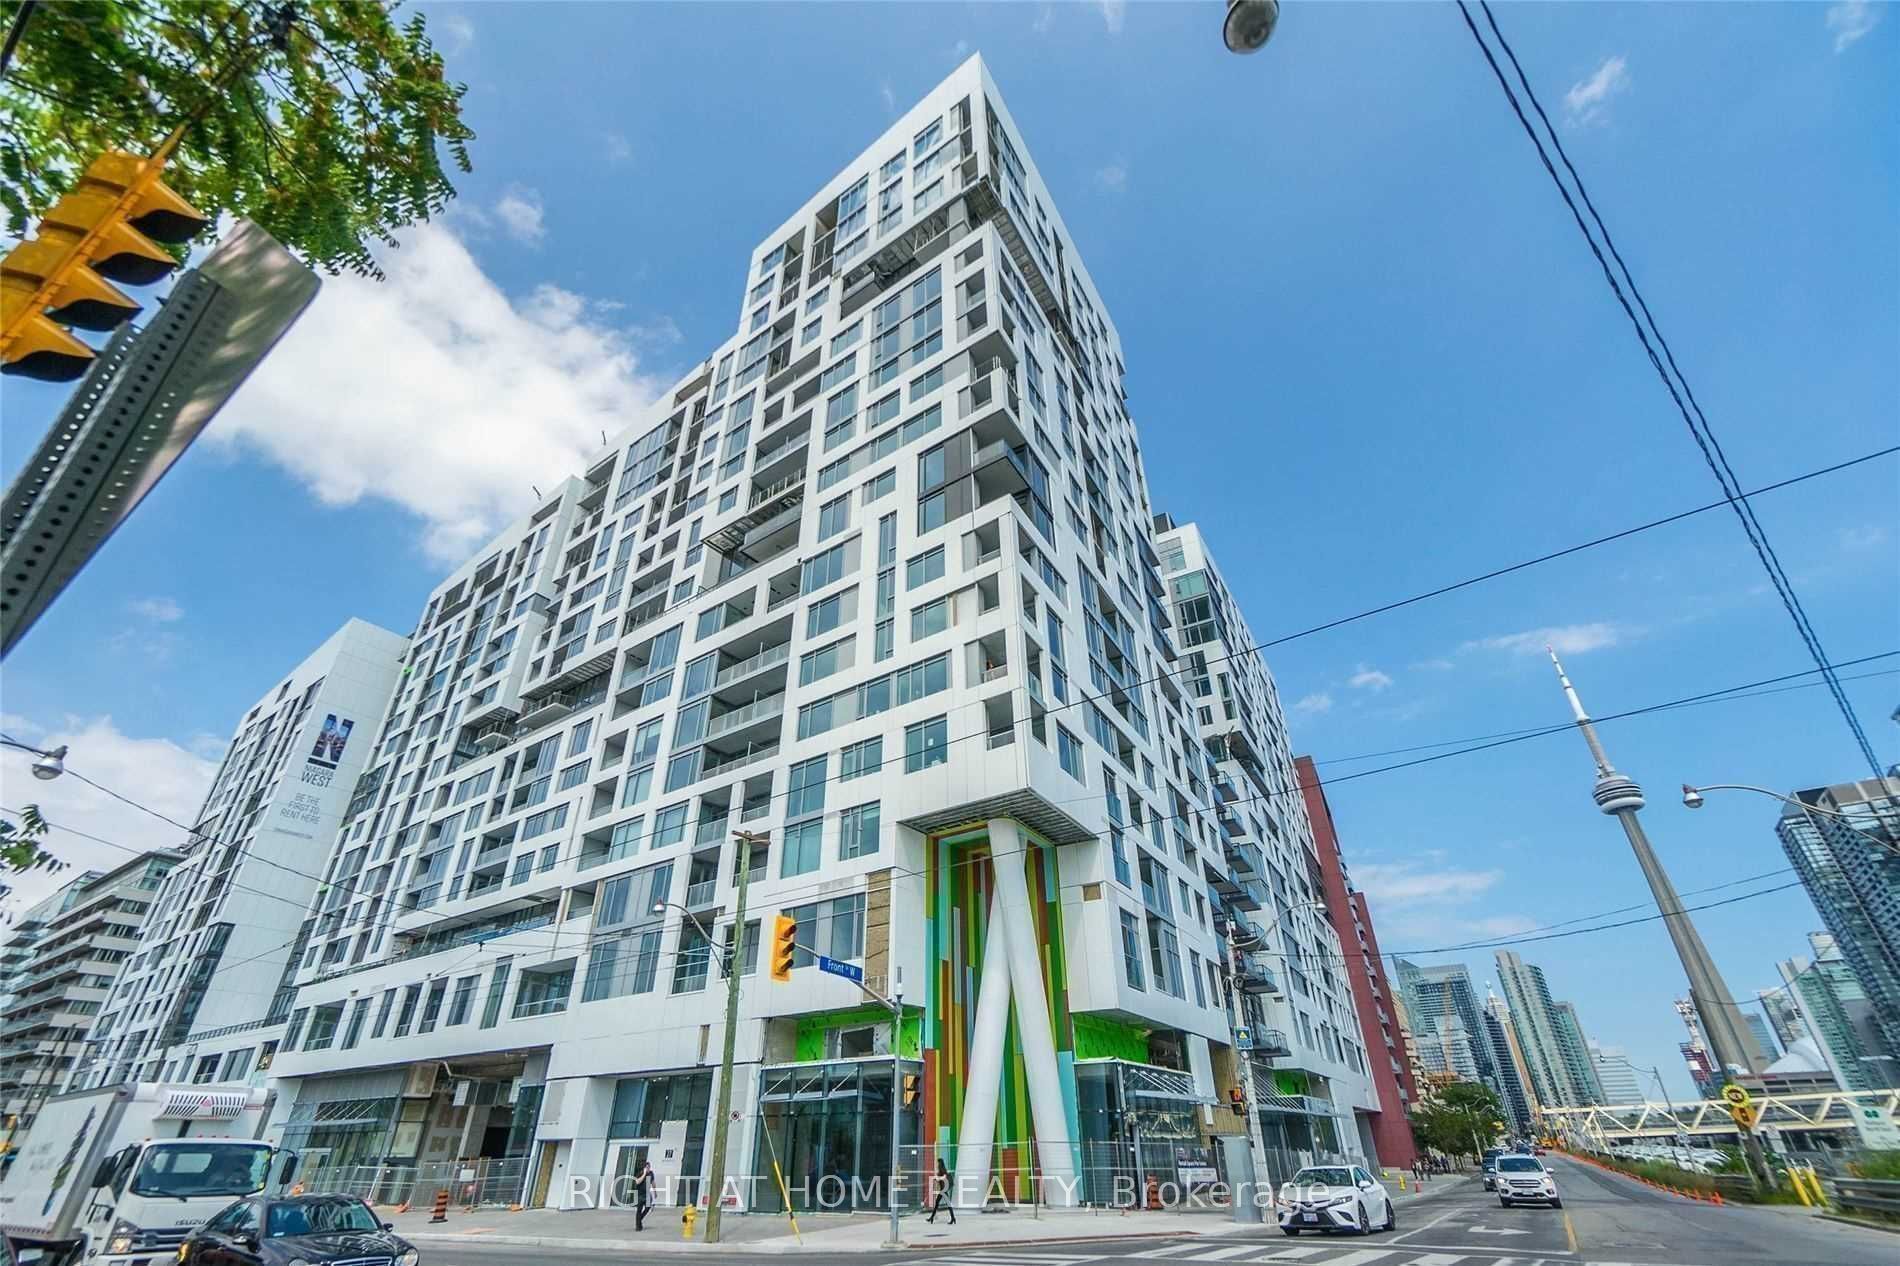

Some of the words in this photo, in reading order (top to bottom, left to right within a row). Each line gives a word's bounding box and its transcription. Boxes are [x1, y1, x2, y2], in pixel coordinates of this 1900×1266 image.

[301, 771, 332, 788] WEST
[827, 959, 844, 974] Front
[175, 1218, 206, 1226] ISUZU
